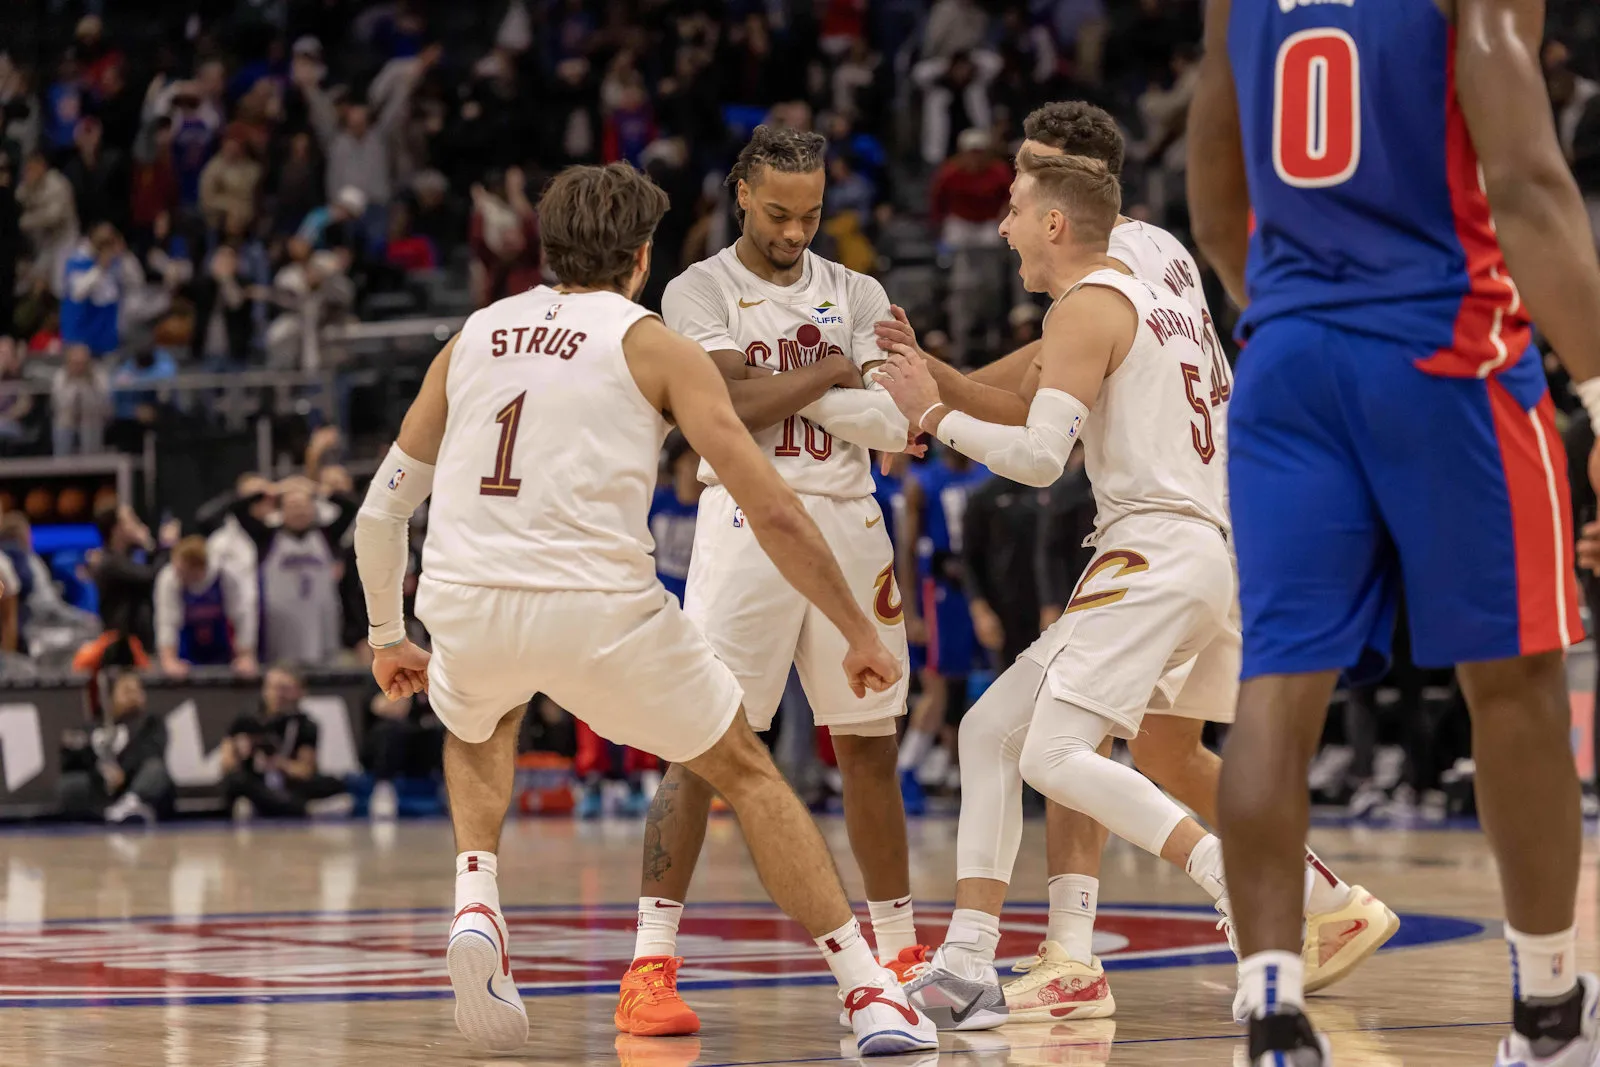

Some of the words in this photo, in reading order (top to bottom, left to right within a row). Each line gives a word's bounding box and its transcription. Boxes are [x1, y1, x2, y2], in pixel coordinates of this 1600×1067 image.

[1272, 27, 1361, 189] 0
[1163, 258, 1195, 298] NIANG
[491, 326, 587, 360] STRUS
[744, 338, 844, 372] CAV
[1145, 307, 1206, 356] MERRILL
[775, 414, 832, 461] 10
[1180, 362, 1216, 465] 5
[480, 390, 527, 497] 1
